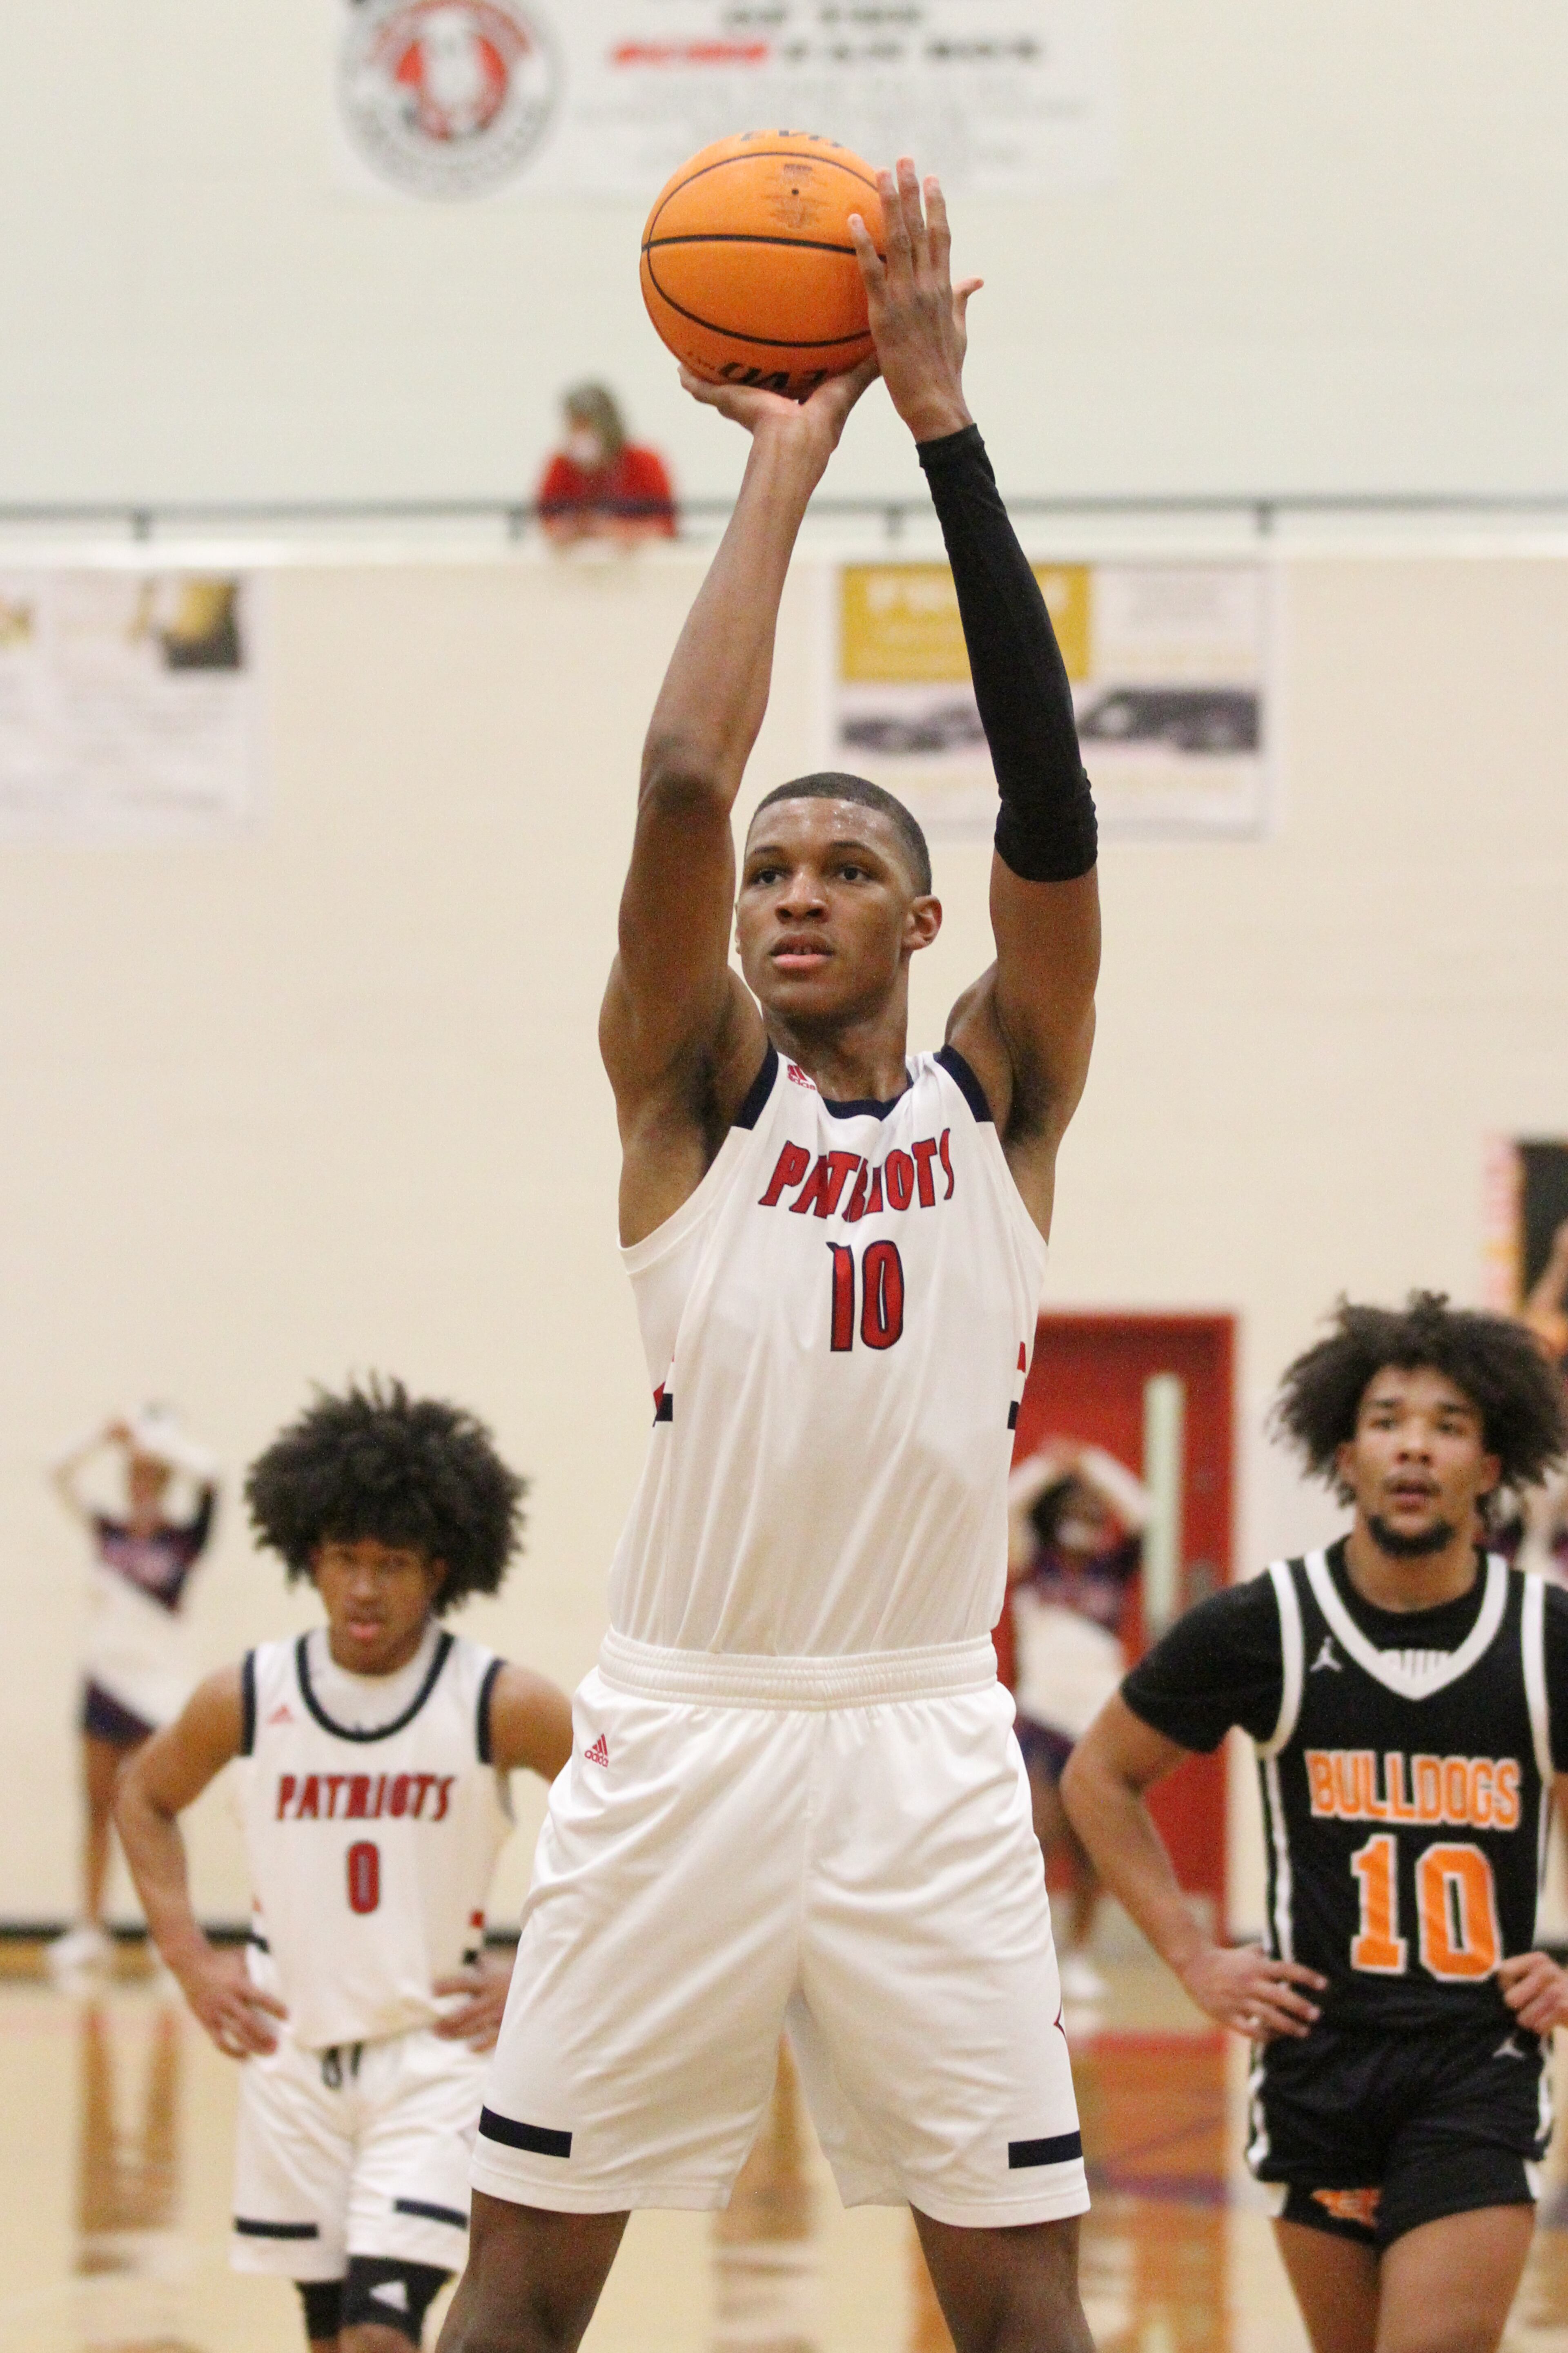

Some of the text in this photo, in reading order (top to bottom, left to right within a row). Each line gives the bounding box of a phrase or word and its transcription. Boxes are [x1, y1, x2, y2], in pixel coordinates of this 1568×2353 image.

[758, 1128, 954, 1222] PATRIOTS
[826, 1240, 904, 1352] 10
[276, 1771, 455, 1822] PATRIOTS
[1304, 1749, 1522, 1831] BULLDOGS
[346, 1839, 381, 1915] 0
[1350, 1833, 1503, 1983] 10
